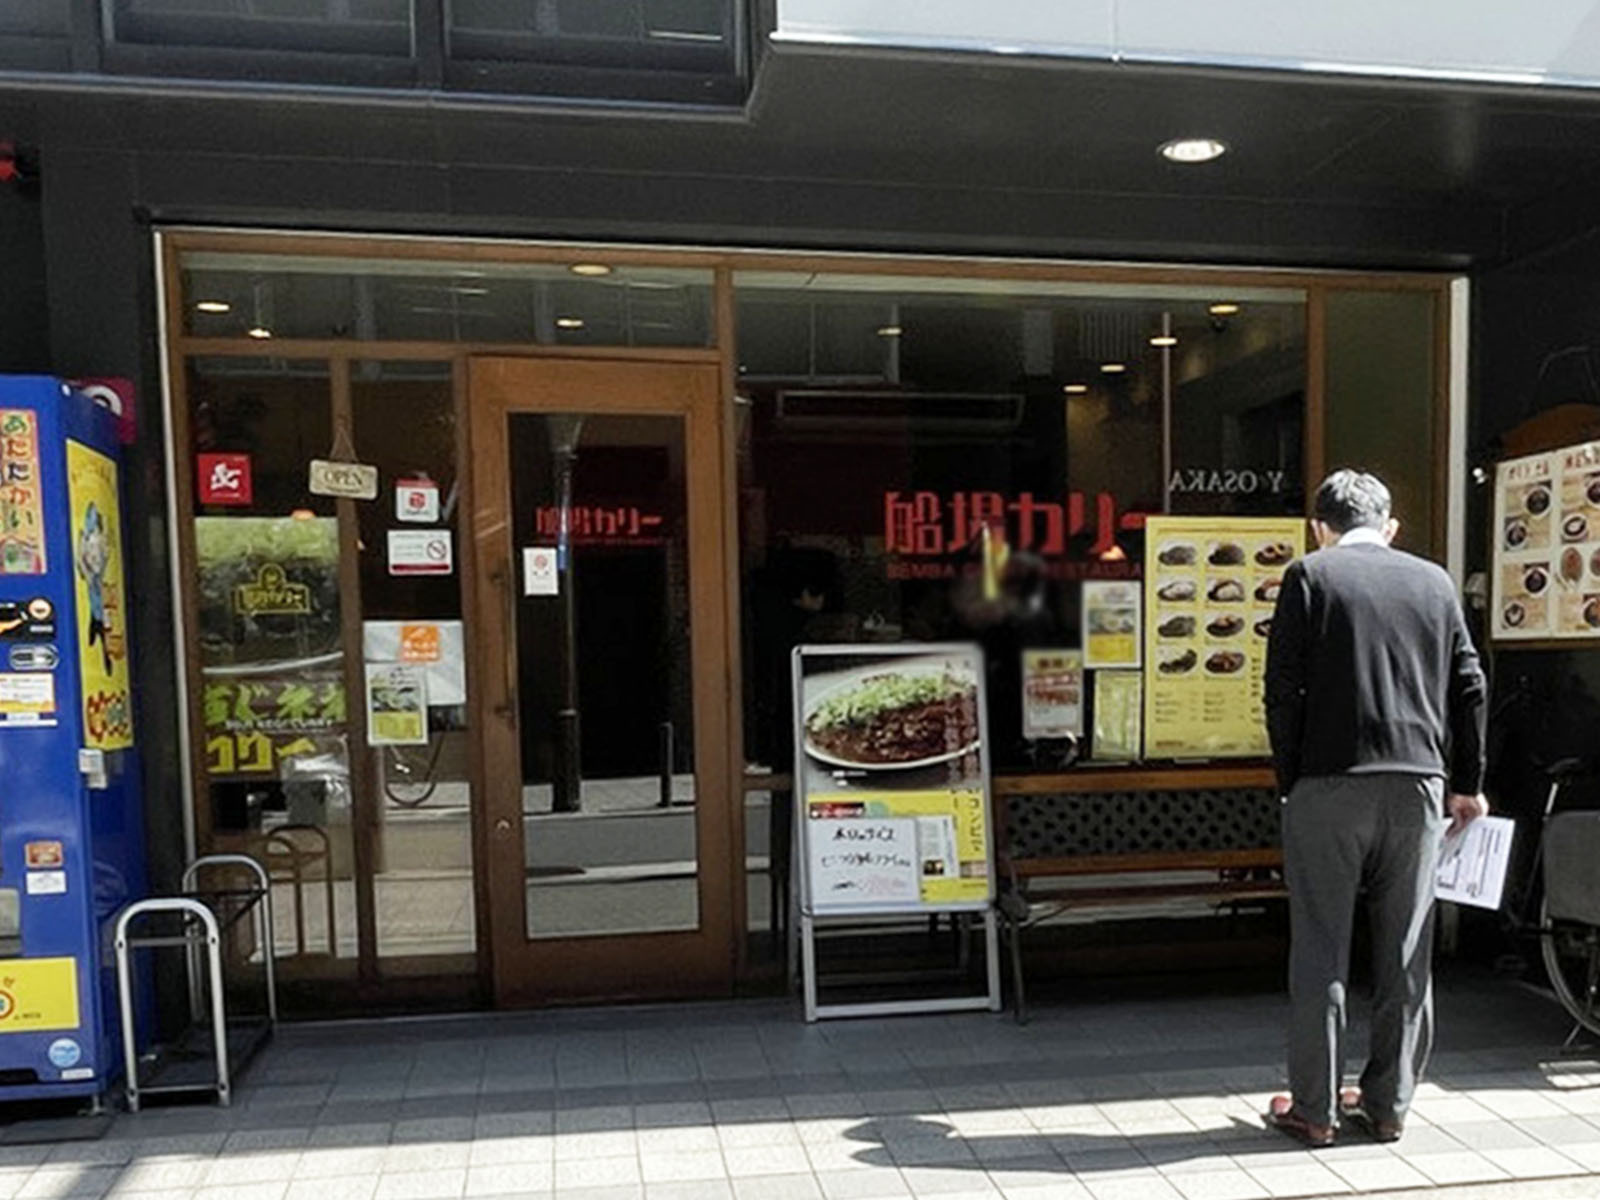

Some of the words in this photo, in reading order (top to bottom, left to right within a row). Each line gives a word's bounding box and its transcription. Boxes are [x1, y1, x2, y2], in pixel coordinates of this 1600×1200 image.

[324, 469, 363, 487] OPEN
[885, 491, 1148, 556] 船場カリー
